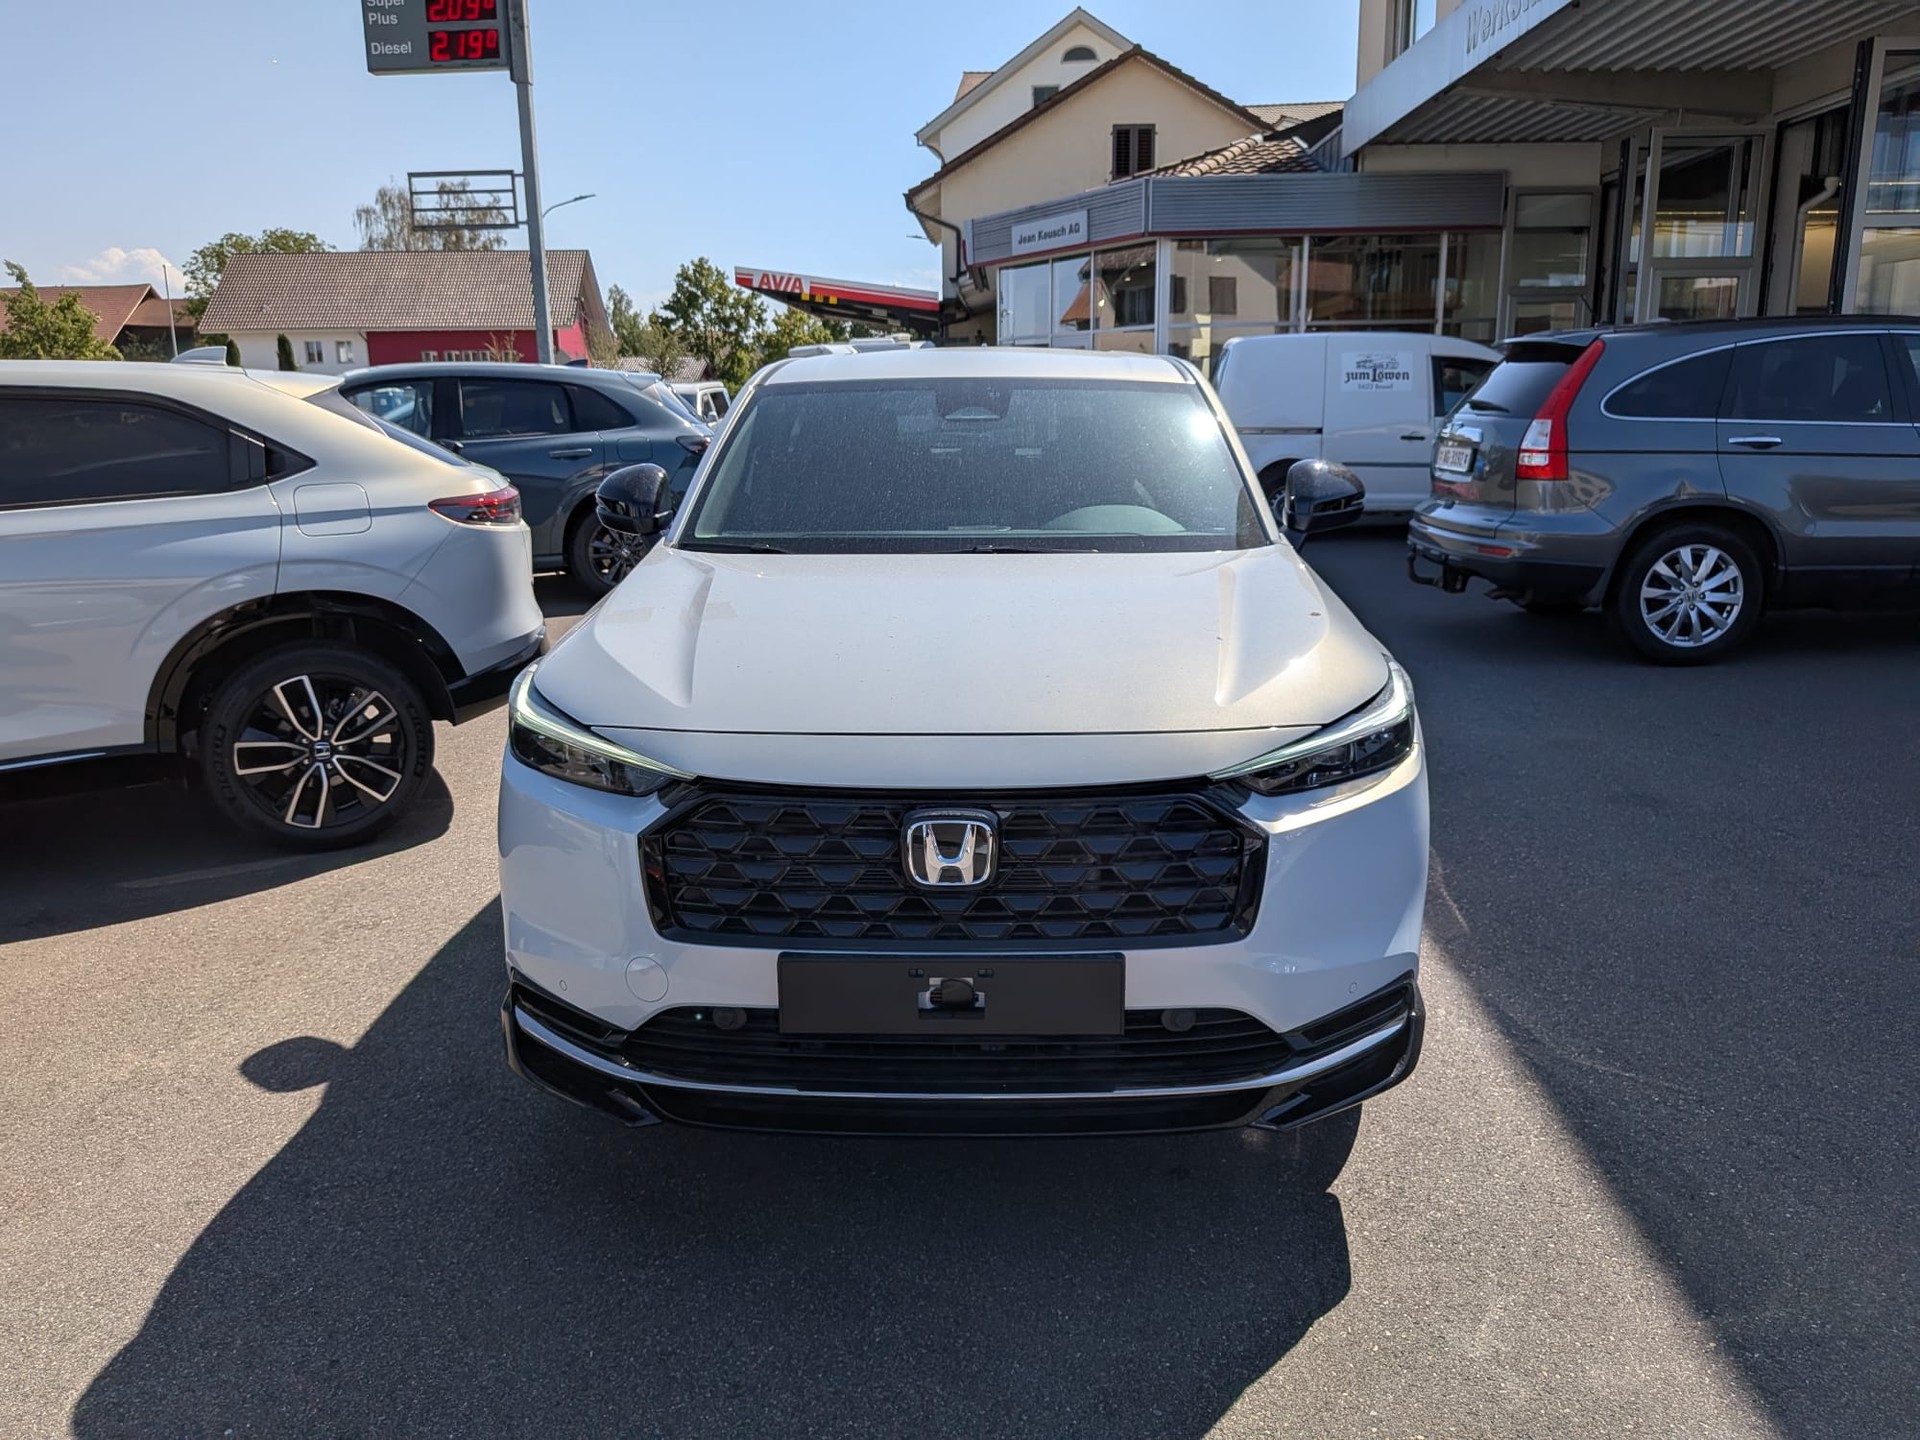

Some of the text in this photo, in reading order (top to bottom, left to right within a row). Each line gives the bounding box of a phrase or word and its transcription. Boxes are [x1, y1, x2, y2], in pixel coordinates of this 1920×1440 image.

[368, 12, 398, 25] Plus
[371, 41, 412, 55] Diesel
[1018, 222, 1081, 245] Jean Keusch AG
[758, 273, 804, 293] AVIA
